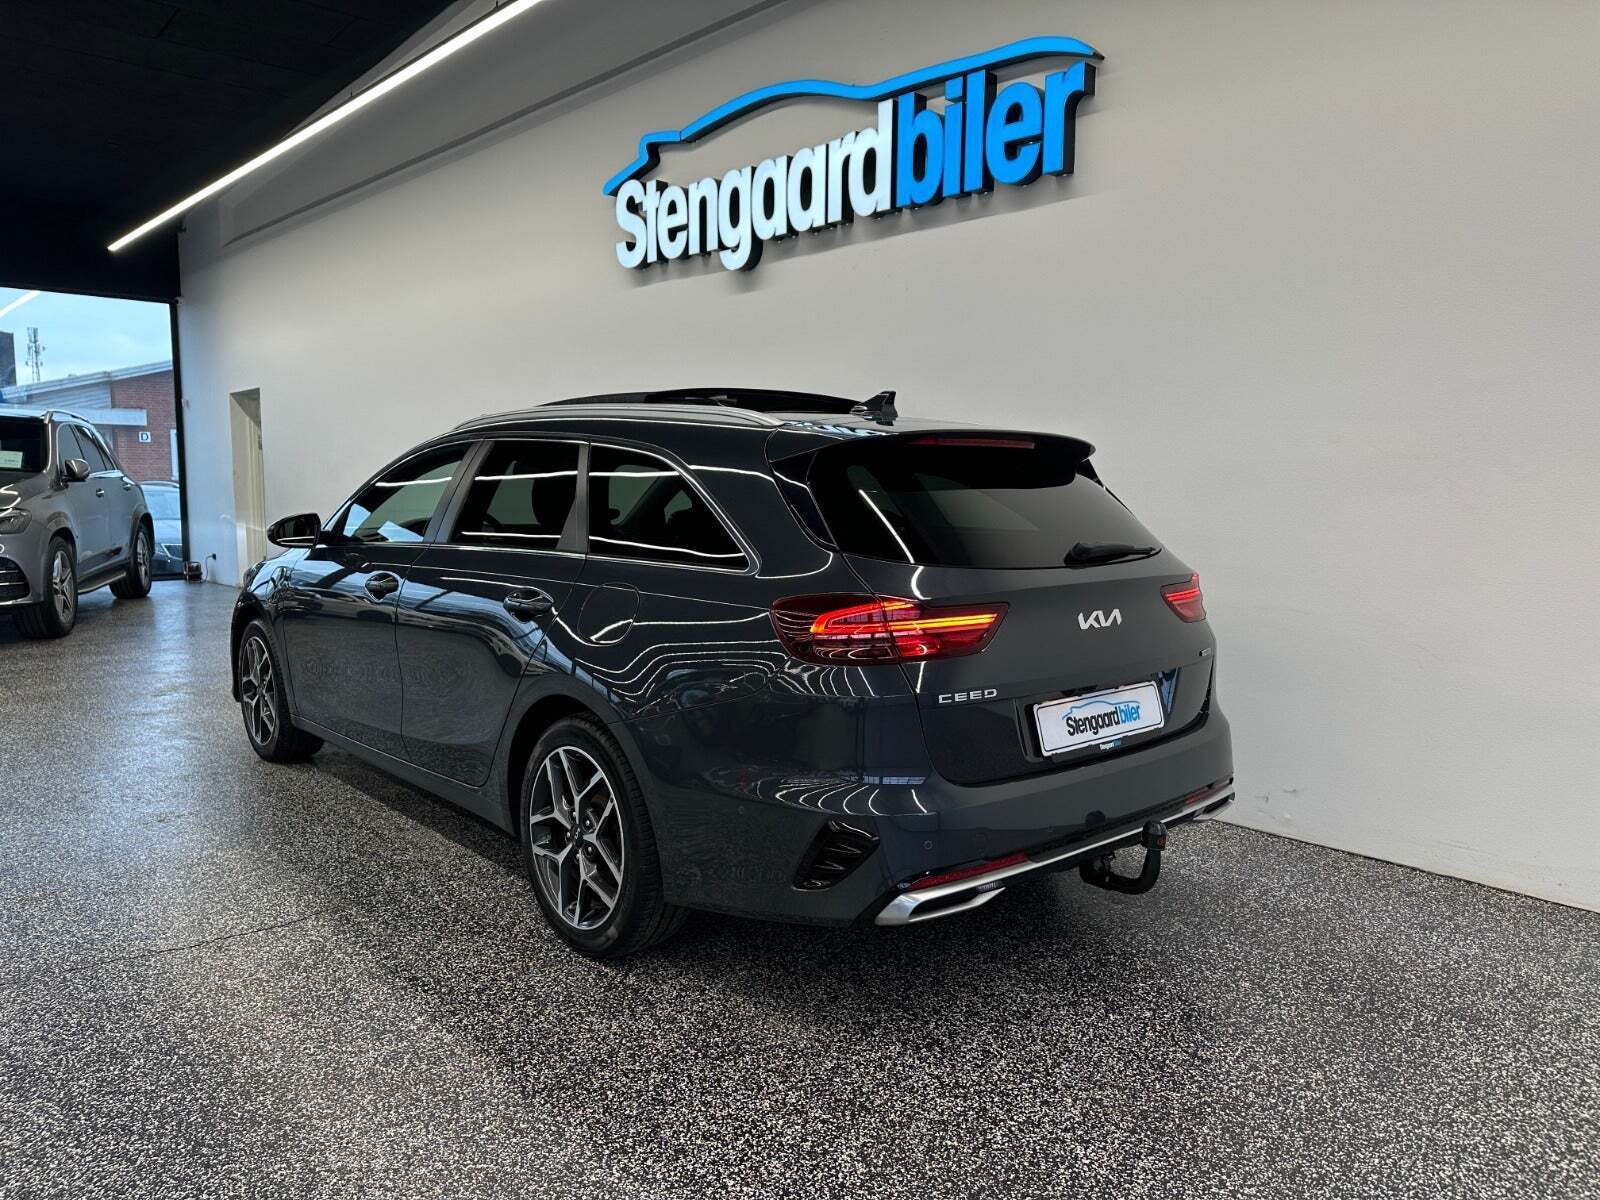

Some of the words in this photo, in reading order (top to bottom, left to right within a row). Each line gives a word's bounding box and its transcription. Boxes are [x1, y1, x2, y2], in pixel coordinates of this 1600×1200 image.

[140, 432, 149, 441] D
[1078, 608, 1122, 630] KIA
[938, 688, 998, 704] CEED
